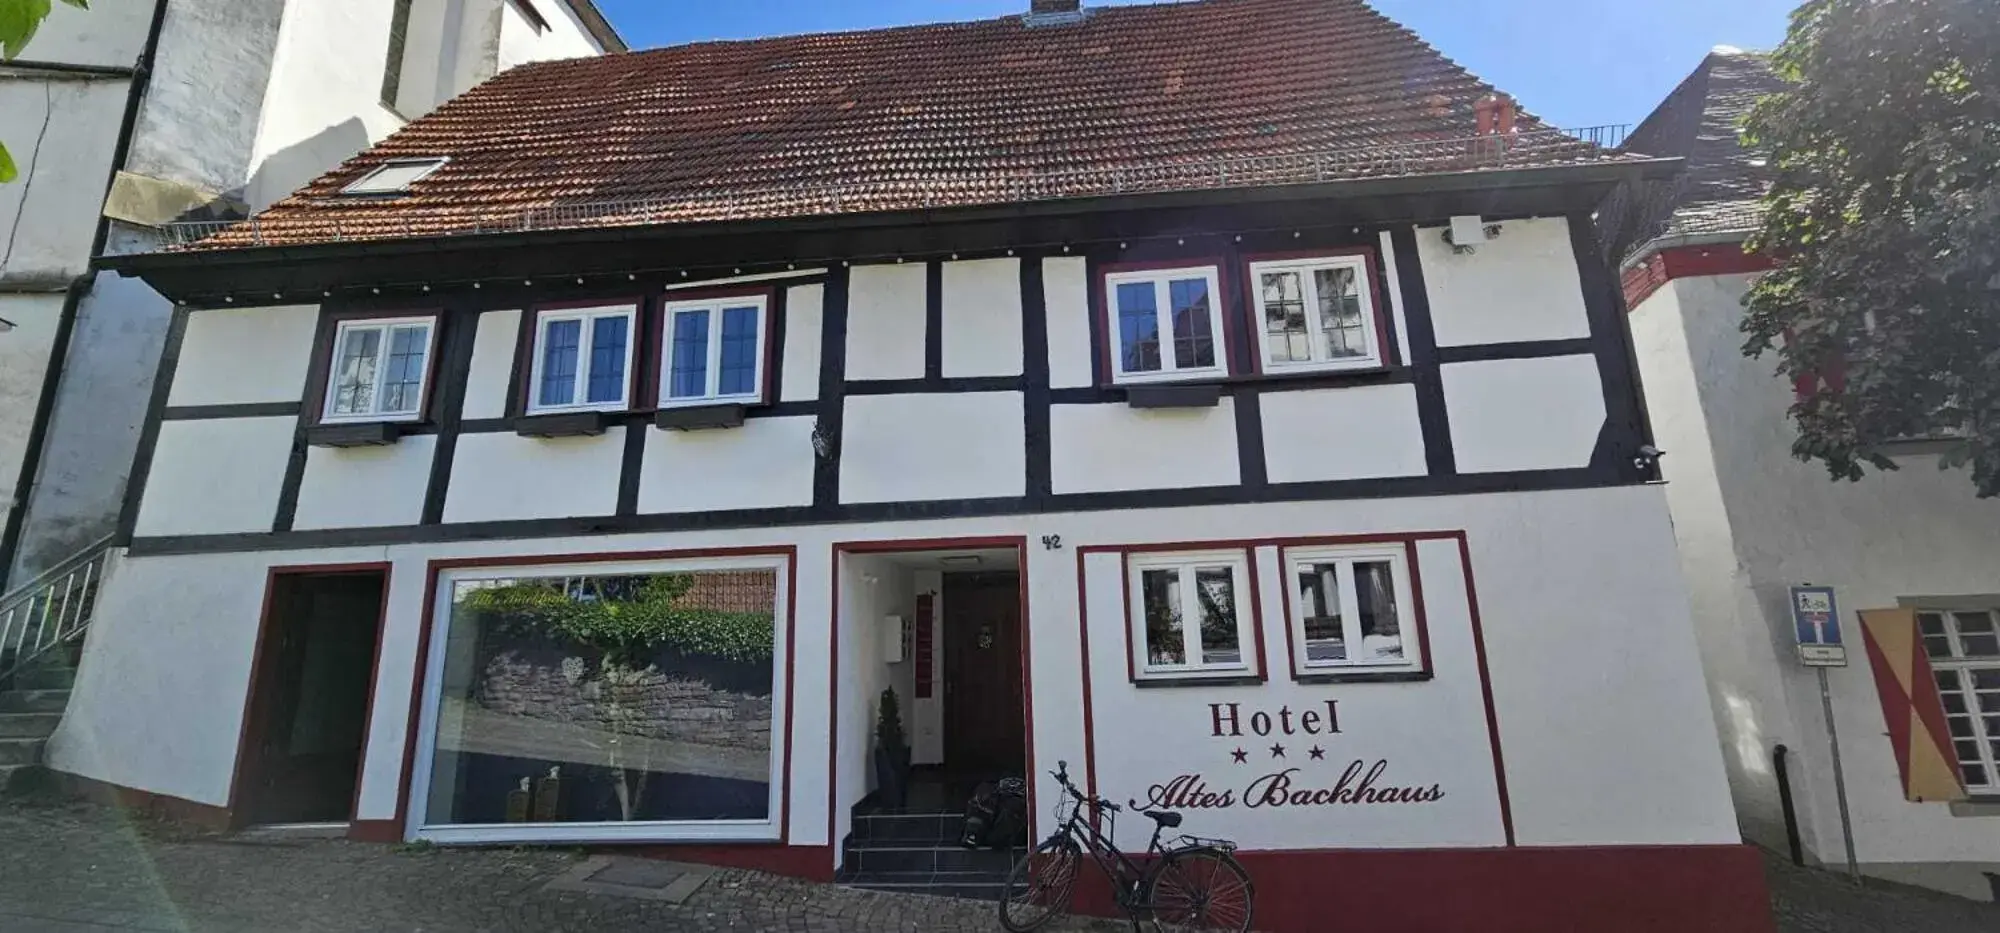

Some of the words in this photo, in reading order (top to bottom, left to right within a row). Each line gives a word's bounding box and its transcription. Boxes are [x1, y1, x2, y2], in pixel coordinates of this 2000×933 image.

[1042, 535, 1062, 551] 42
[1208, 700, 1342, 736] Hotel
[1129, 775, 1236, 812] Altes
[1244, 759, 1445, 808] Backhaus
